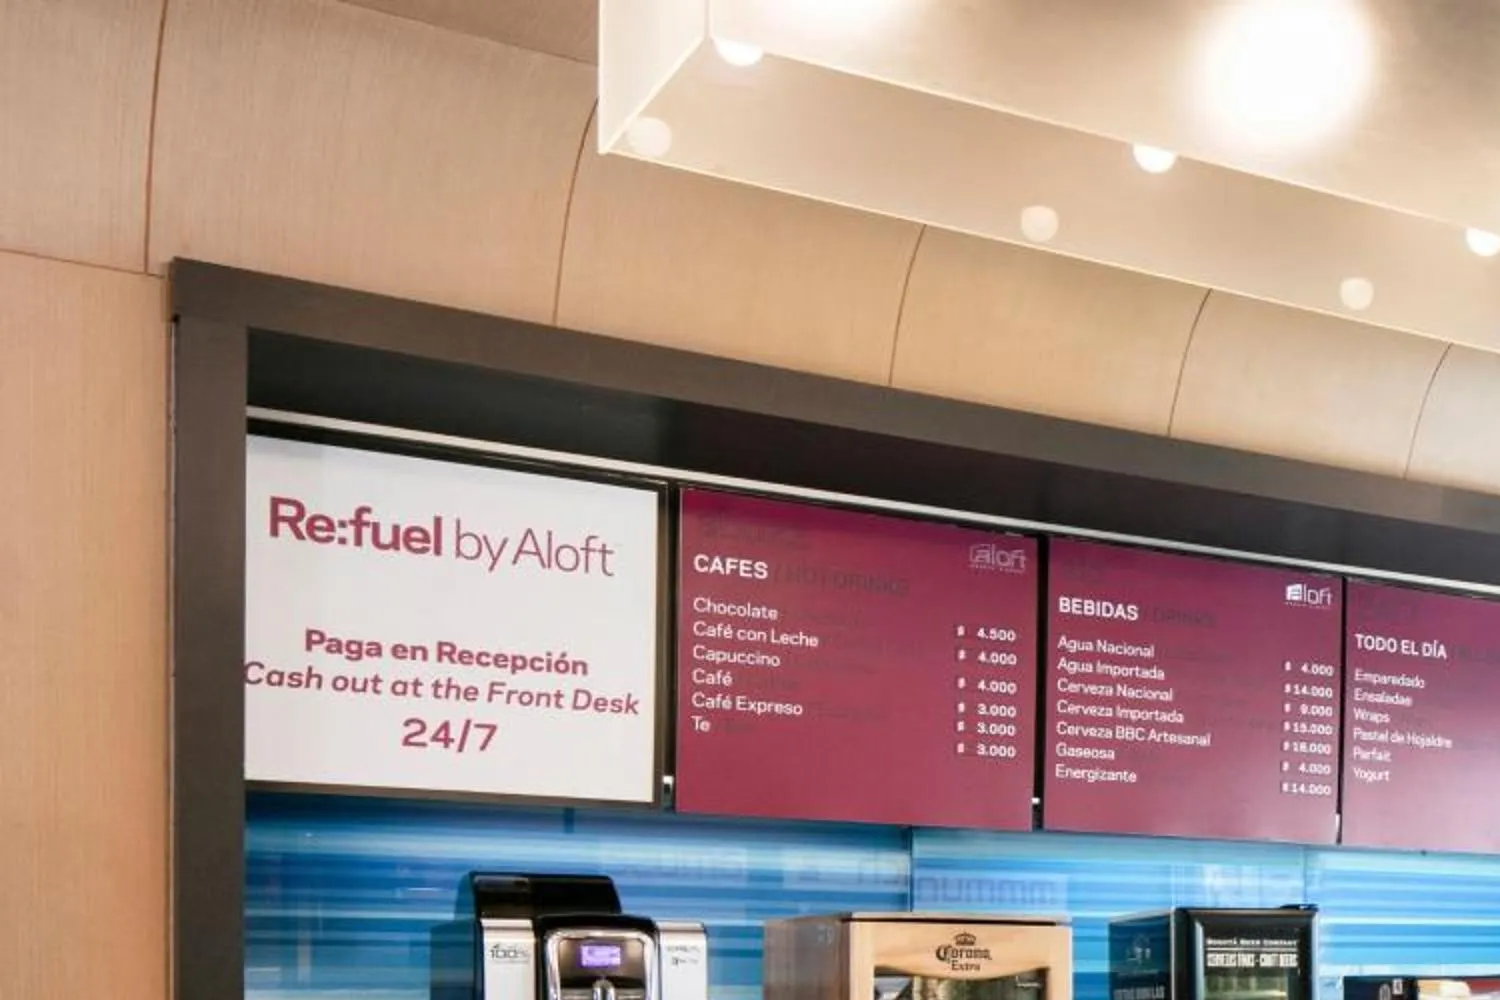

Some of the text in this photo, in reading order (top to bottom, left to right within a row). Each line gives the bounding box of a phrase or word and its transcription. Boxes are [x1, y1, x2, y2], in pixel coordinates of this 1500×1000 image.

[269, 496, 615, 577] Re:fuel by Aloft
[694, 554, 768, 580] CAFES
[693, 597, 778, 621] Chocolate
[1058, 596, 1139, 621] BEBIDAS
[693, 621, 819, 648] Café con Leche
[977, 627, 1017, 642] 4.500
[1057, 635, 1155, 658] Agua Nacional
[1354, 633, 1397, 653] TODO
[1401, 640, 1419, 656] EL
[1422, 640, 1448, 660] DÍA
[305, 629, 589, 676] Paga en Recepción
[692, 646, 781, 669] Capuccino
[977, 651, 1018, 666] 4.000
[692, 668, 733, 687] Café
[1057, 657, 1166, 681] Agua Importada
[244, 661, 640, 716] Cash out at the Front Desk
[977, 679, 1018, 695] 4.000
[1057, 678, 1173, 702] Cerveza Nacional
[691, 692, 803, 717] Café Expreso
[1057, 700, 1184, 725] Cerveza Importada
[402, 717, 498, 753] 24/7
[691, 716, 710, 733] Te
[1056, 720, 1212, 747] Cerveza BBC Artesanal
[1055, 763, 1137, 783] Energizante
[935, 945, 993, 964] Corona
[951, 960, 981, 972] Extra
